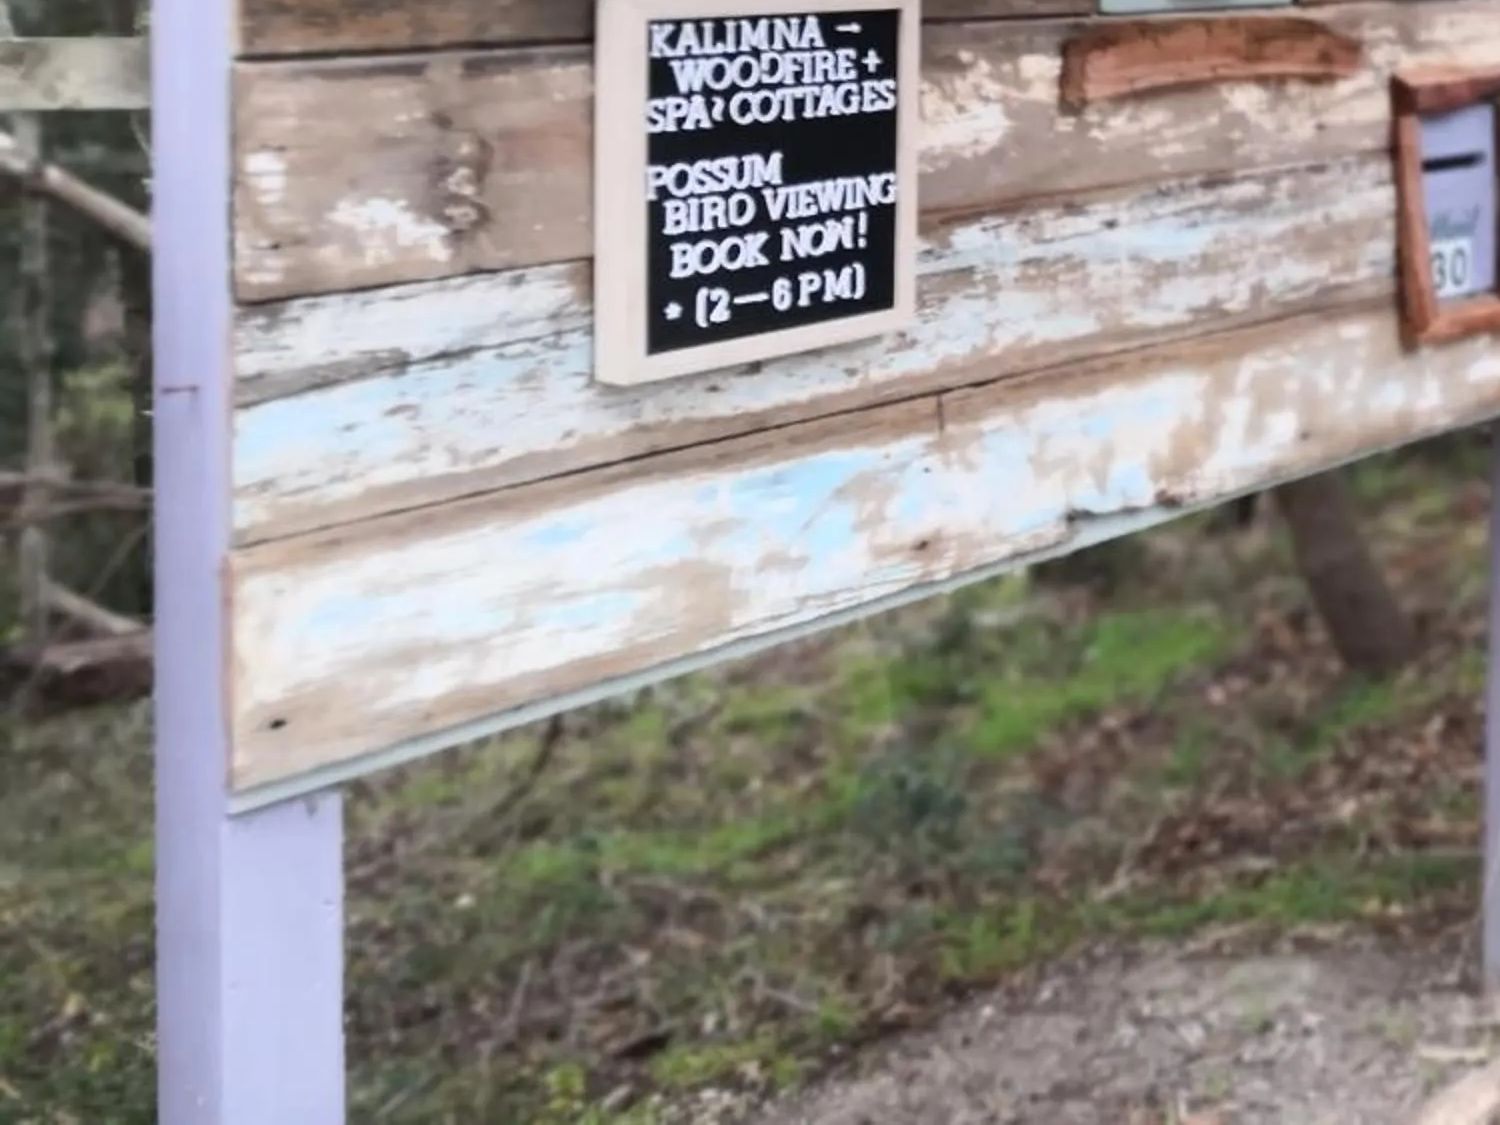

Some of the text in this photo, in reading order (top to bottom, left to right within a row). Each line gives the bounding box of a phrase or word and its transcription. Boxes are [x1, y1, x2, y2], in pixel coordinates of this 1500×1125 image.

[650, 15, 826, 57] KALIMNA
[669, 49, 857, 93] WOODFIRE
[729, 79, 896, 124] COTTAGES
[646, 151, 783, 201] POSSUM
[761, 172, 897, 221] VIEWING
[669, 231, 770, 278] BOOK
